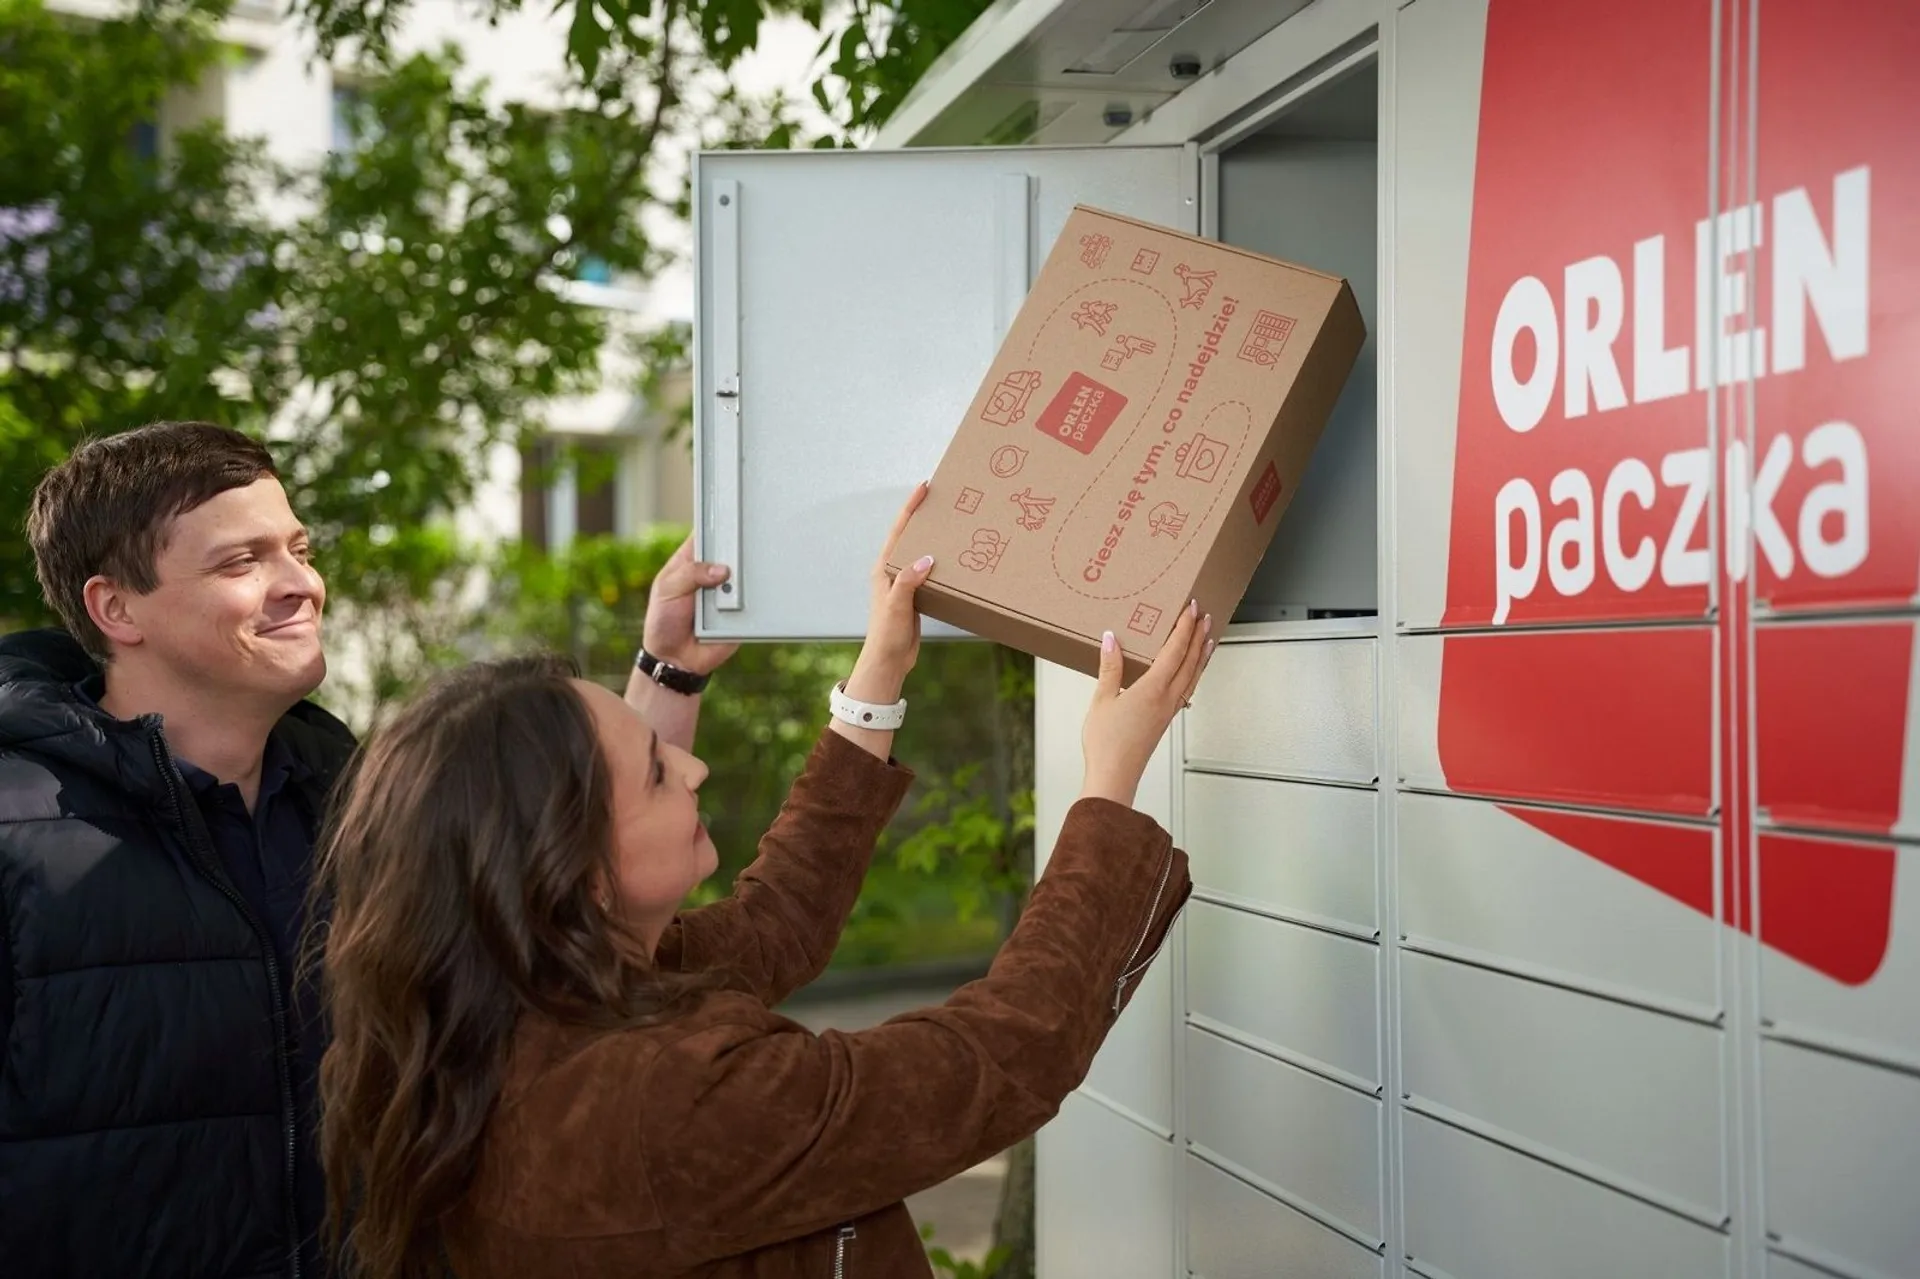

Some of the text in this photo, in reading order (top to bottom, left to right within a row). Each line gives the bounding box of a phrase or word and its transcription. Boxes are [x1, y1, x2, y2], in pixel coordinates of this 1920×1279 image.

[1491, 165, 1870, 433] ORLEN
[1059, 385, 1094, 437] ORLEN
[1072, 390, 1105, 442] paczka
[1083, 296, 1240, 583] Ciesz się tym, co nadejdzie!
[1492, 421, 1870, 626] paczka
